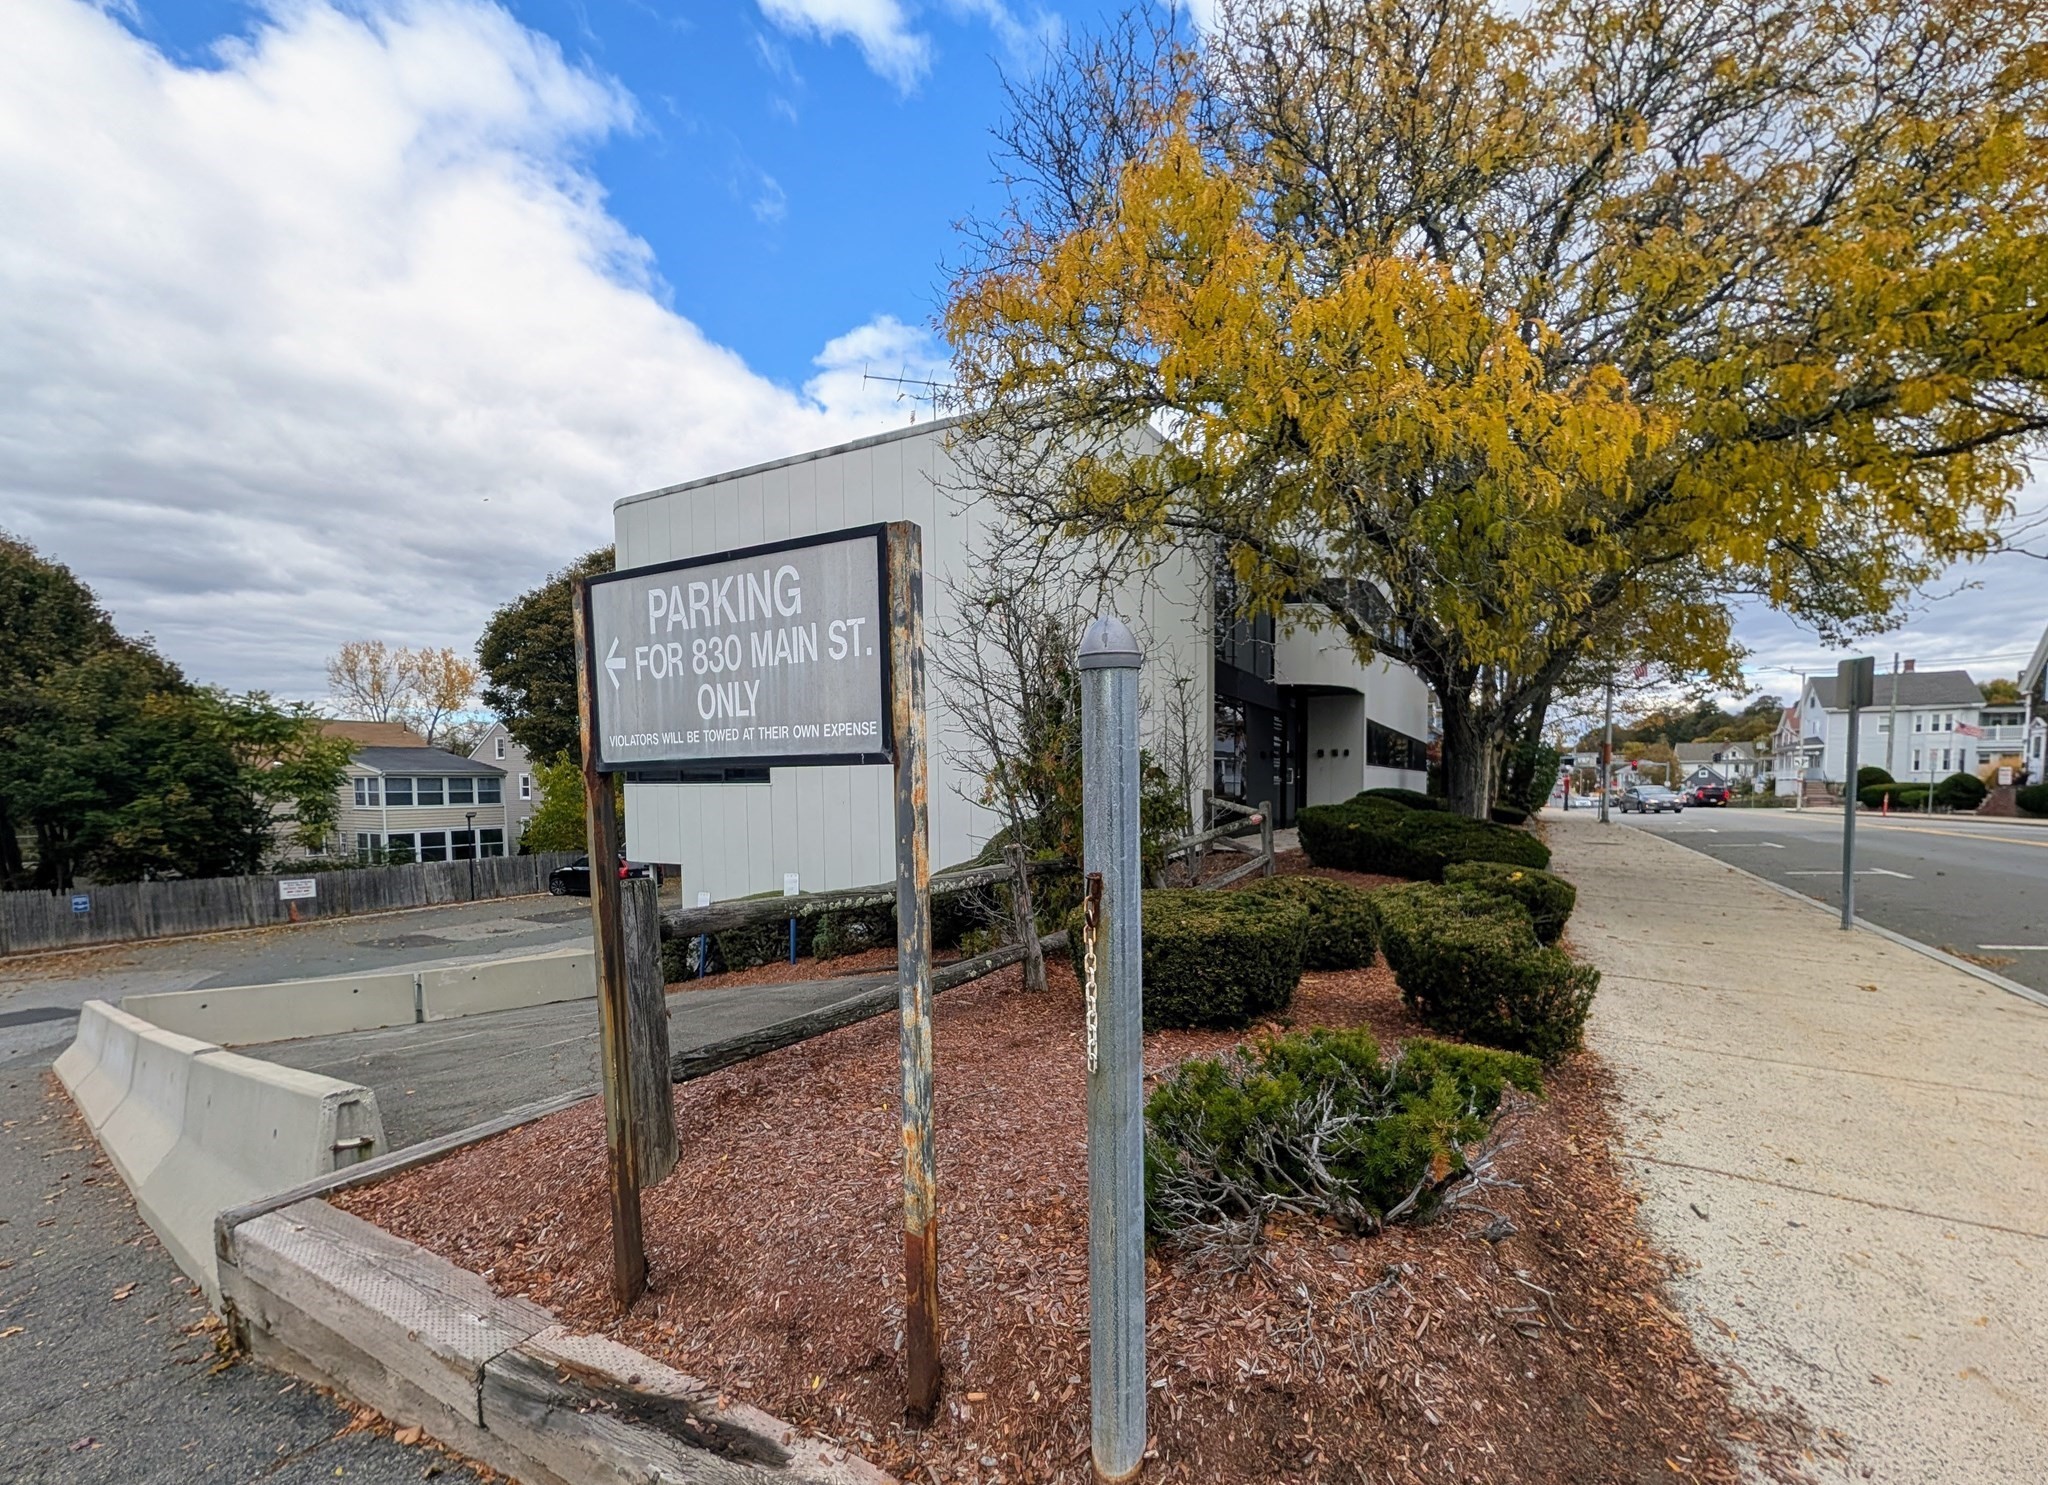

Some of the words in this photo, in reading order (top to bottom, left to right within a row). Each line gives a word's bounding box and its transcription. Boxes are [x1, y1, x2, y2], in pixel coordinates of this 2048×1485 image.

[648, 565, 802, 635] PARKING
[635, 642, 684, 681] FOR
[692, 634, 742, 675] 830
[750, 622, 818, 669] MAIN
[828, 617, 873, 661] ST.
[697, 679, 760, 720] ONLY
[609, 732, 659, 748] VIOLATORS
[661, 731, 684, 744] WILL
[686, 730, 700, 743] BE
[703, 728, 740, 742] TOWED
[742, 727, 755, 740] AT
[758, 725, 789, 740] THEIR
[793, 723, 820, 739] OWN
[823, 721, 878, 737] EXPENSE
